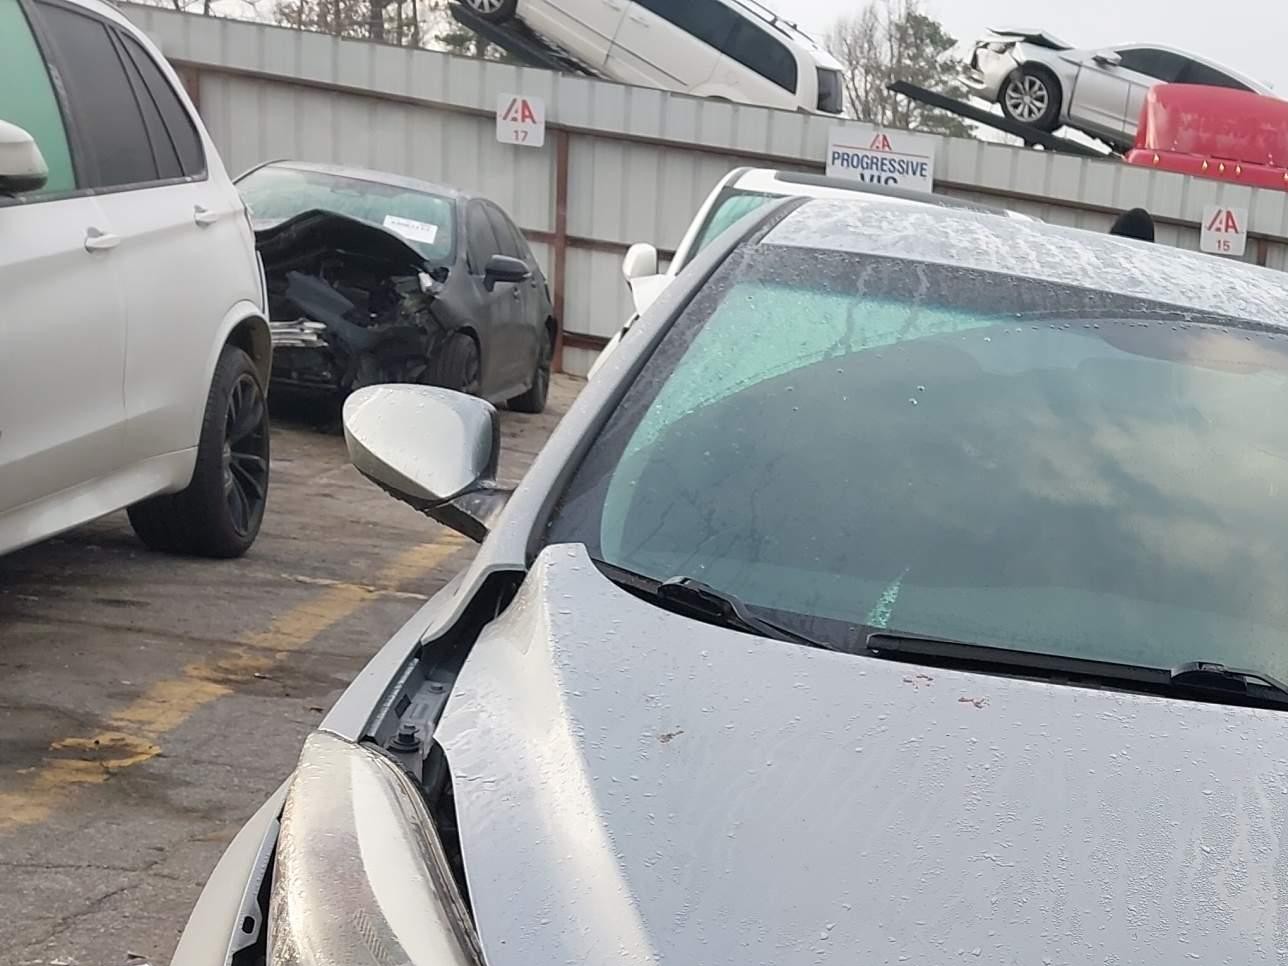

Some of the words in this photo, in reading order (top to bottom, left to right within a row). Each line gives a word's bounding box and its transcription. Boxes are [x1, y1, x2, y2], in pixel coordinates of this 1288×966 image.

[513, 129, 529, 142] 17
[831, 150, 928, 178] PROGRESSIVE
[1216, 239, 1231, 252] 15
